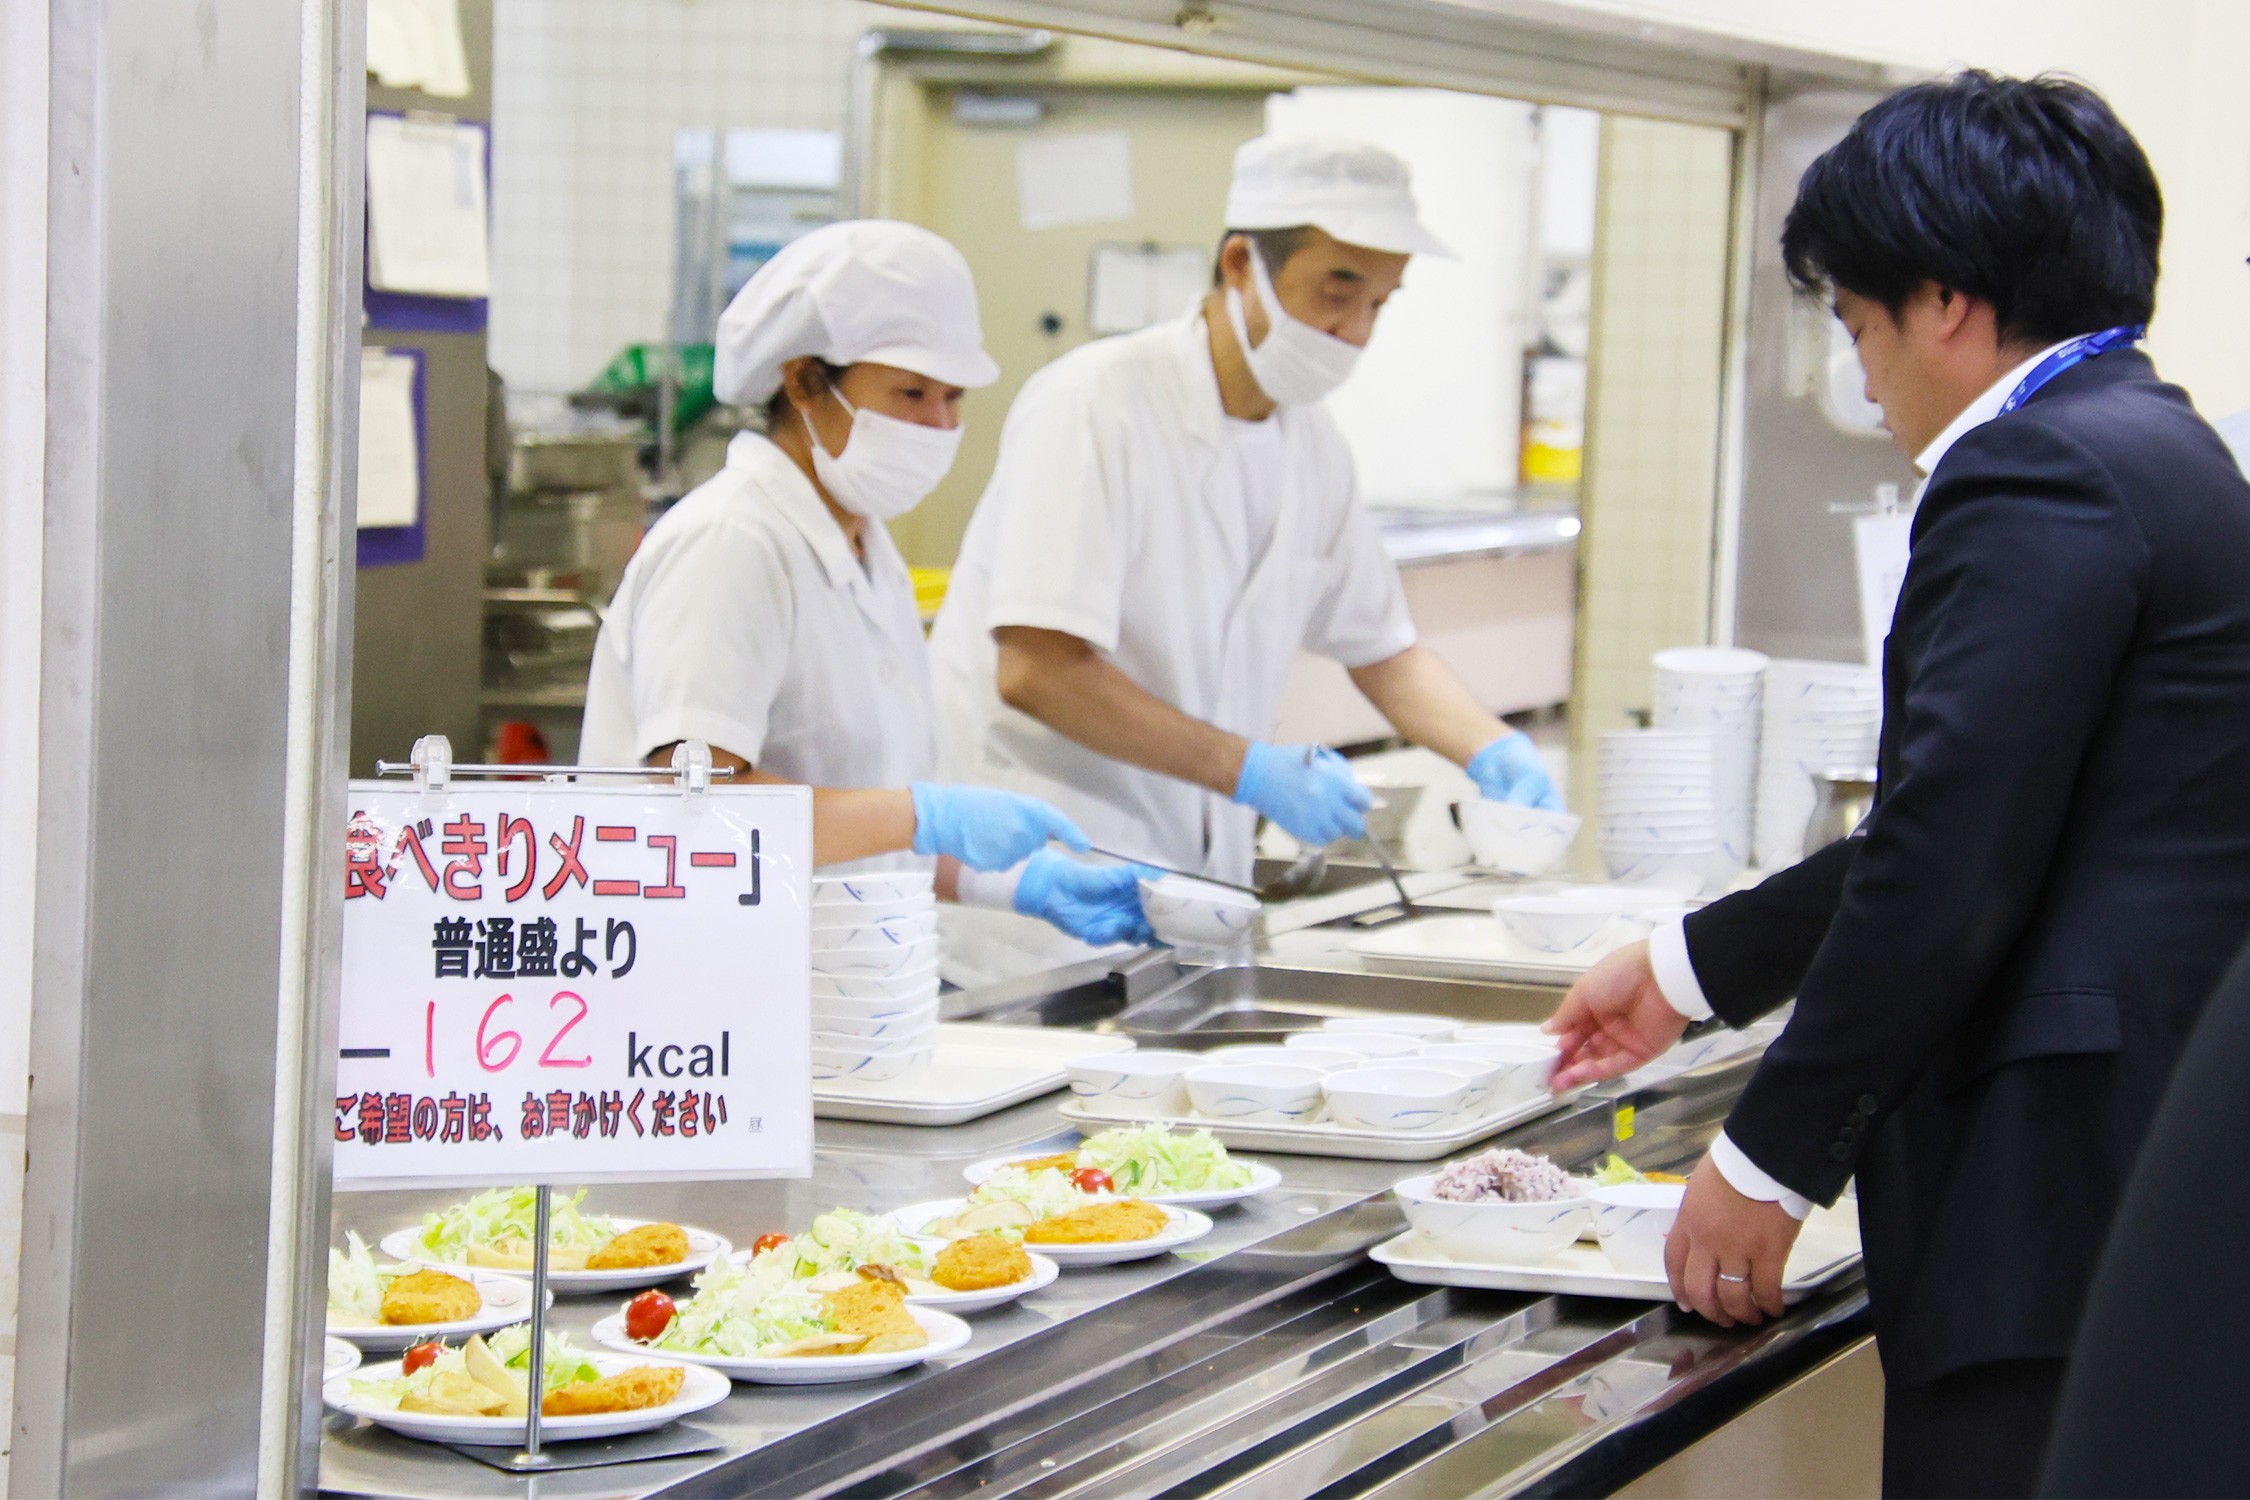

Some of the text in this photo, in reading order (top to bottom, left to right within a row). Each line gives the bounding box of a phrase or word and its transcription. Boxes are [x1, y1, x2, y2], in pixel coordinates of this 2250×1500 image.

[431, 915, 637, 980] 普通盛より
[627, 1030, 730, 1078] kcal
